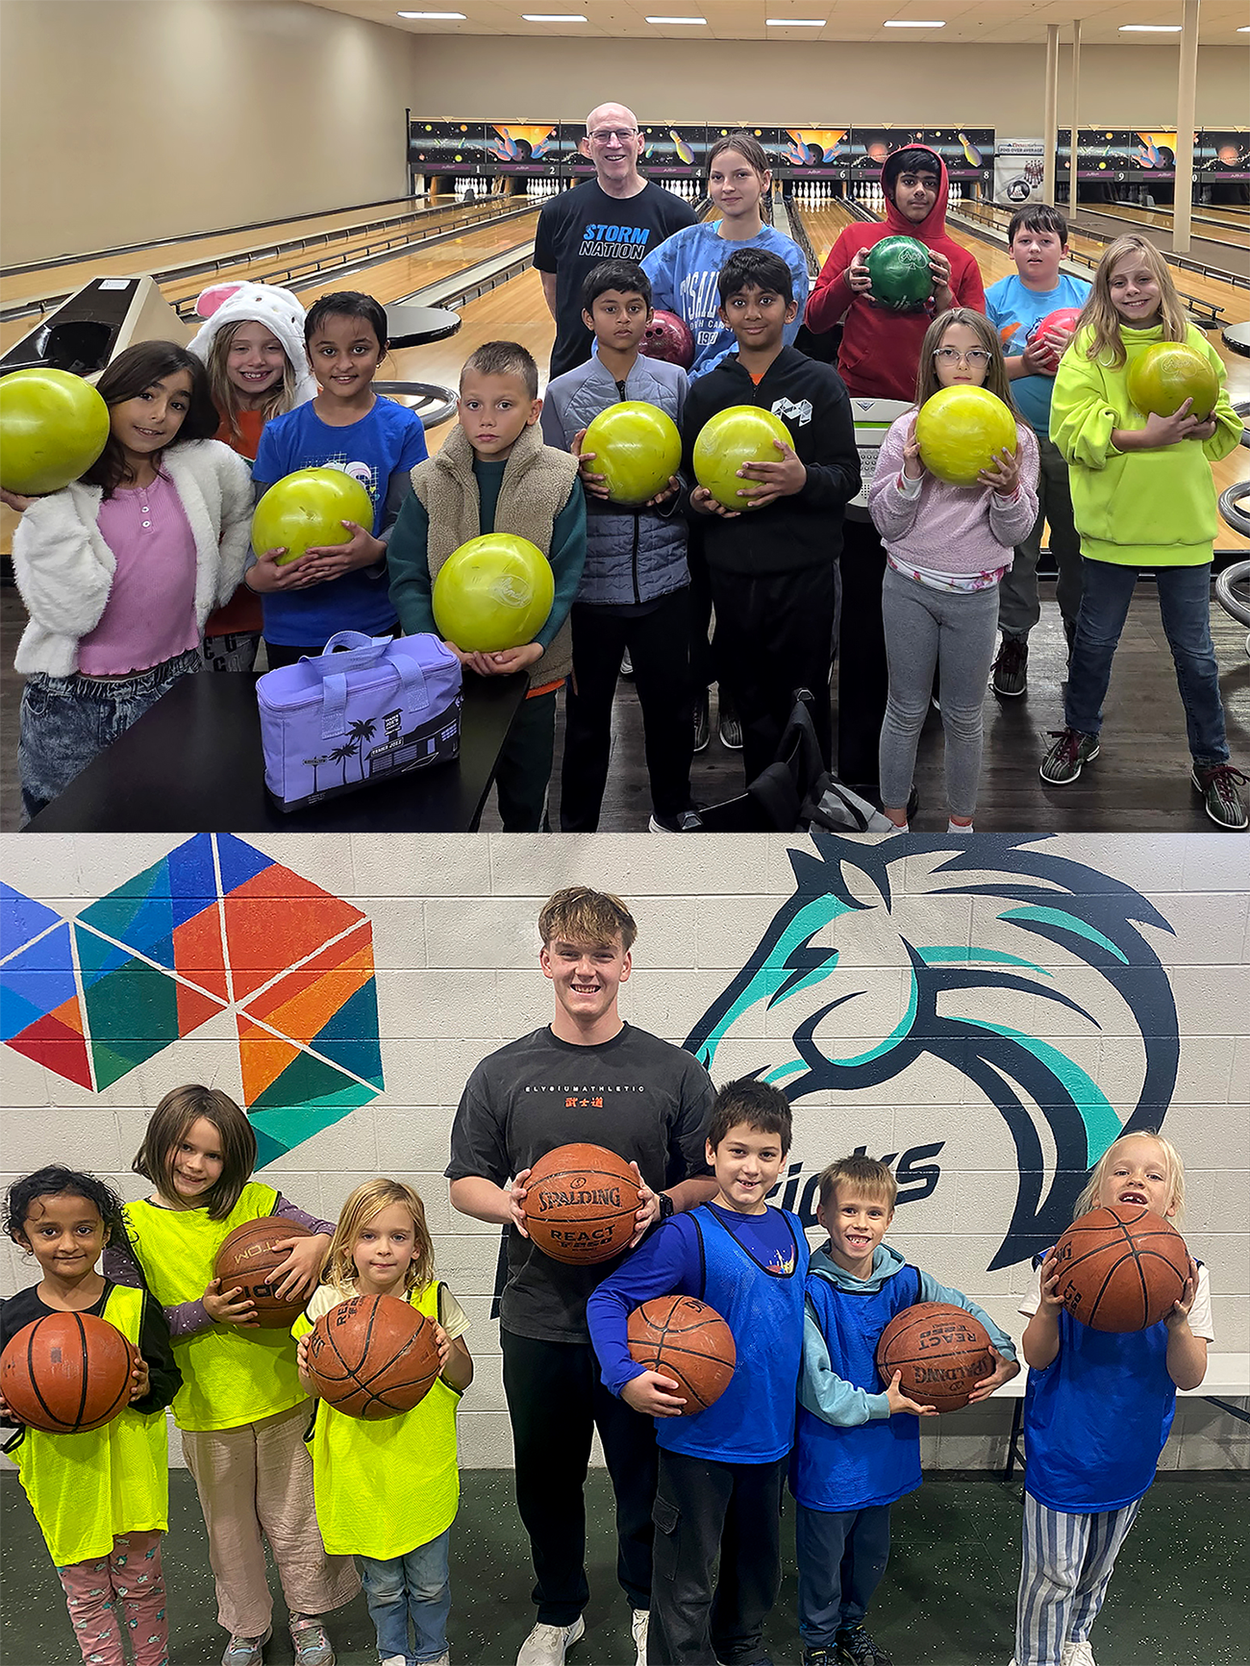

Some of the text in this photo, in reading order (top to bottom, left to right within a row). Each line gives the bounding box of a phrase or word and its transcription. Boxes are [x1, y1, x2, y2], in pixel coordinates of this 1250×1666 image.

[549, 166, 556, 175] 2
[695, 169, 702, 177] 4
[839, 170, 846, 179] 6
[983, 171, 990, 180] 8
[1118, 172, 1125, 181] 9
[583, 223, 650, 245] STORM
[579, 240, 645, 260] NATION
[538, 1187, 623, 1213] SPALDING
[550, 1224, 616, 1241] REACT
[918, 1332, 977, 1351] REACT
[912, 1355, 989, 1384] SPALDING
